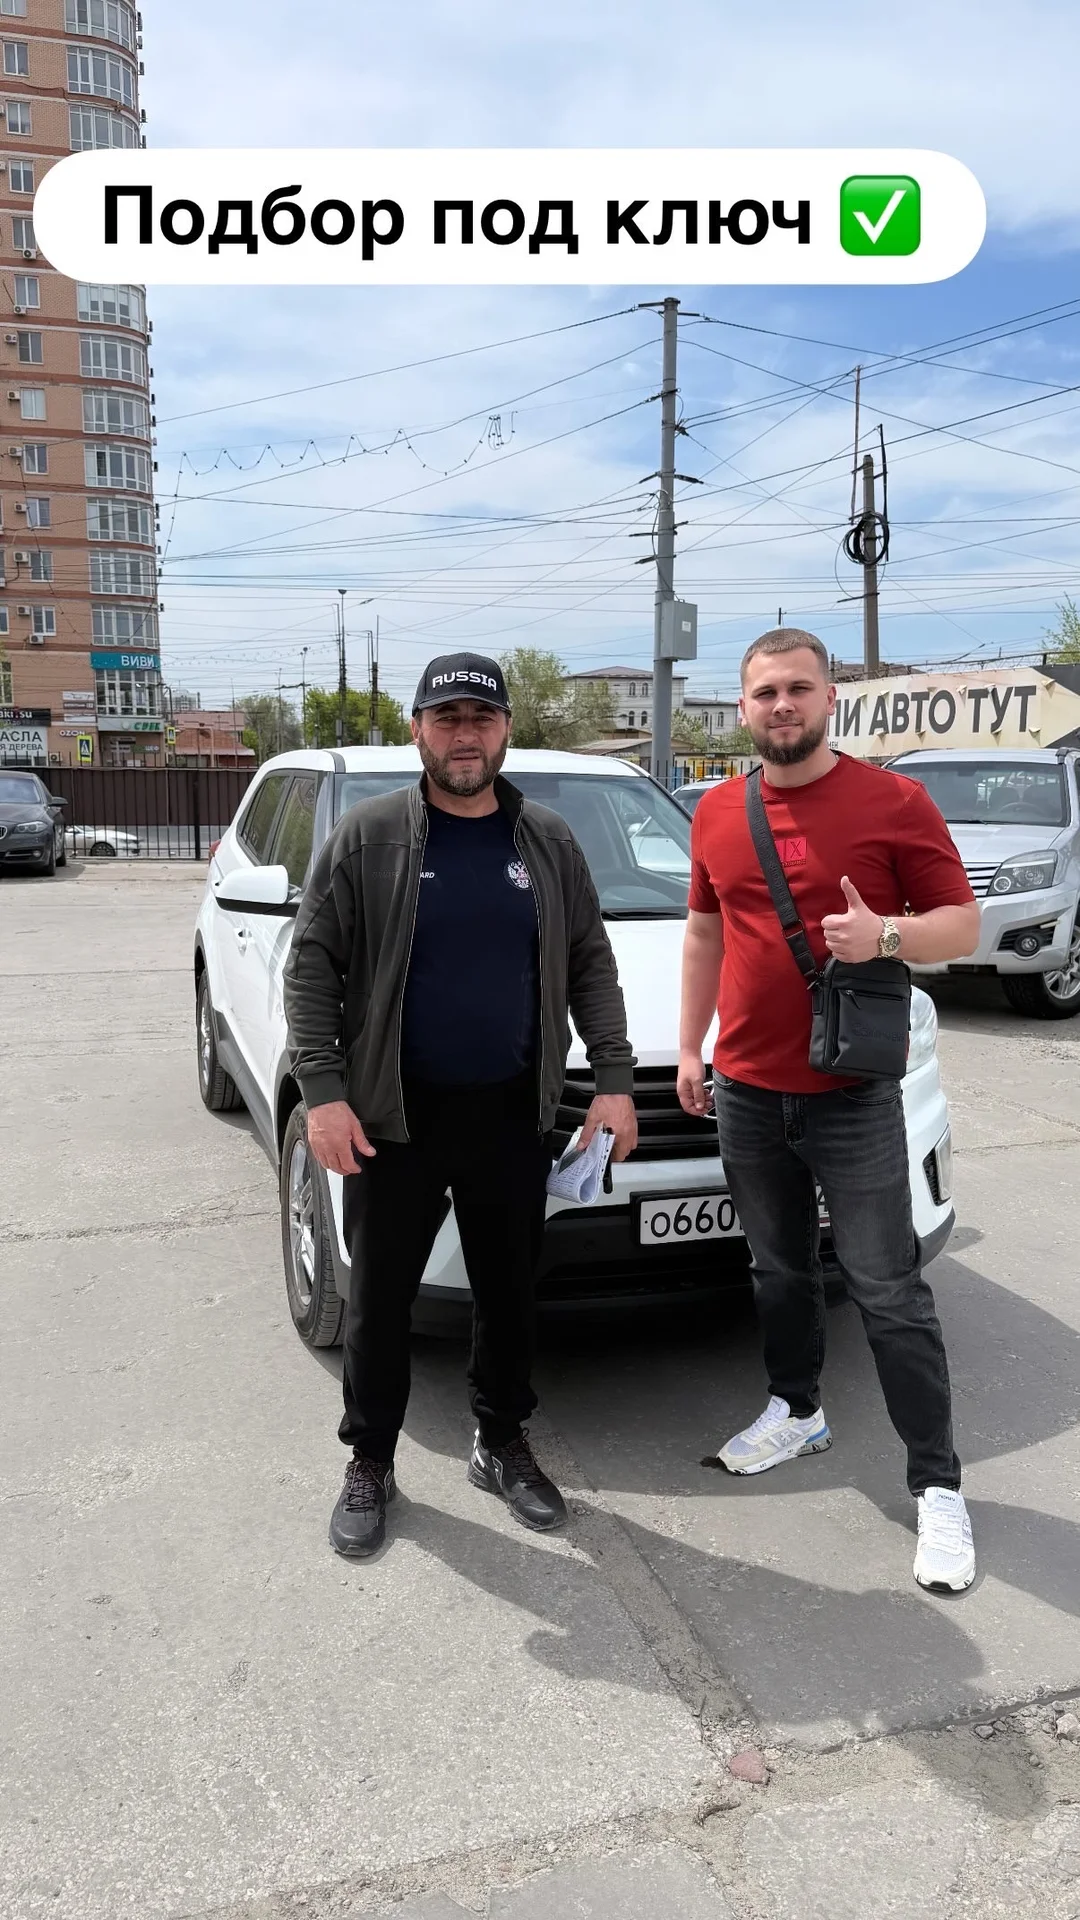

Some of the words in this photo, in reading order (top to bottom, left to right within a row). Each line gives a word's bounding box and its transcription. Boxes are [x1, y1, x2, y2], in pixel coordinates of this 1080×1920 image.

[432, 670, 497, 691] RUSSIA
[869, 690, 956, 736] АВТО
[968, 685, 1037, 733] ТУТ
[0, 731, 42, 742] АСЛА
[9, 743, 44, 751] ДЕРЕВА
[651, 1198, 744, 1238] О660
